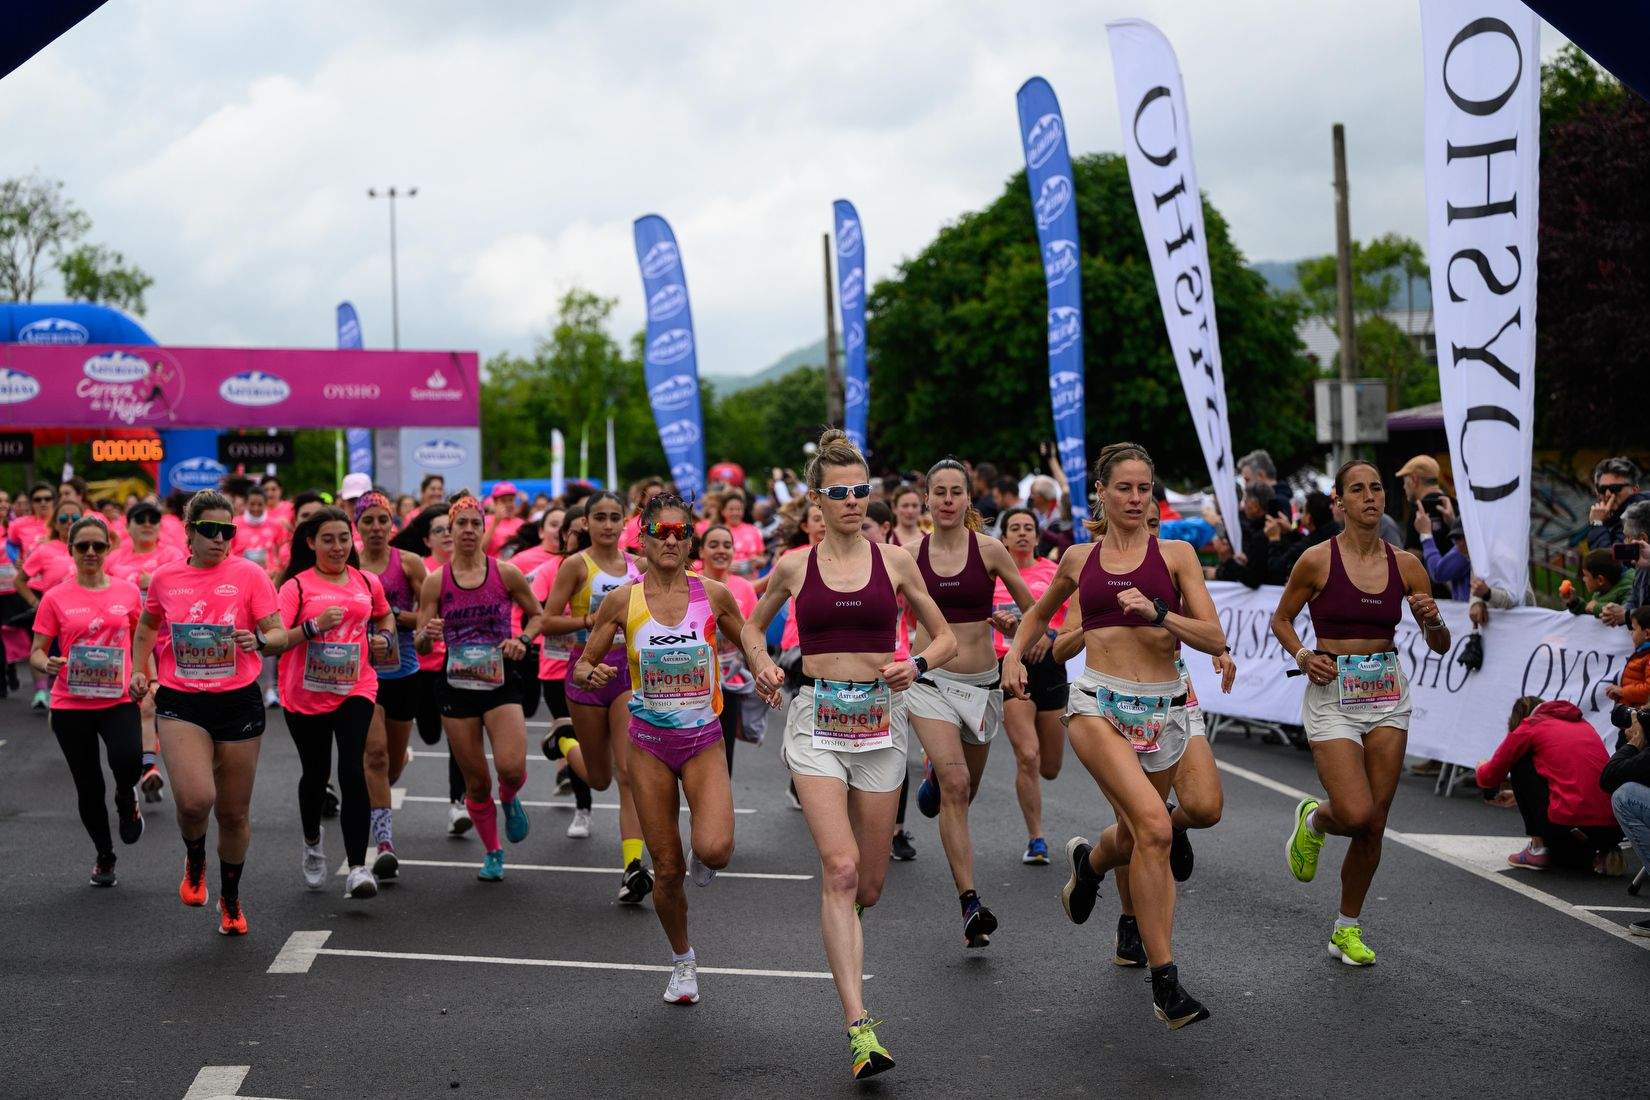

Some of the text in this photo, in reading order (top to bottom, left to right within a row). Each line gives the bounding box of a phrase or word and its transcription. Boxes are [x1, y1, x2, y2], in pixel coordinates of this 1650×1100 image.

[323, 383, 380, 400] OYSHO
[228, 441, 285, 458] OYSHO
[835, 600, 862, 608] OYSHO
[192, 647, 215, 658] 016
[664, 674, 691, 685] 016
[1361, 680, 1384, 691] 016
[839, 713, 868, 725] 016
[821, 739, 846, 747] OYSHO
